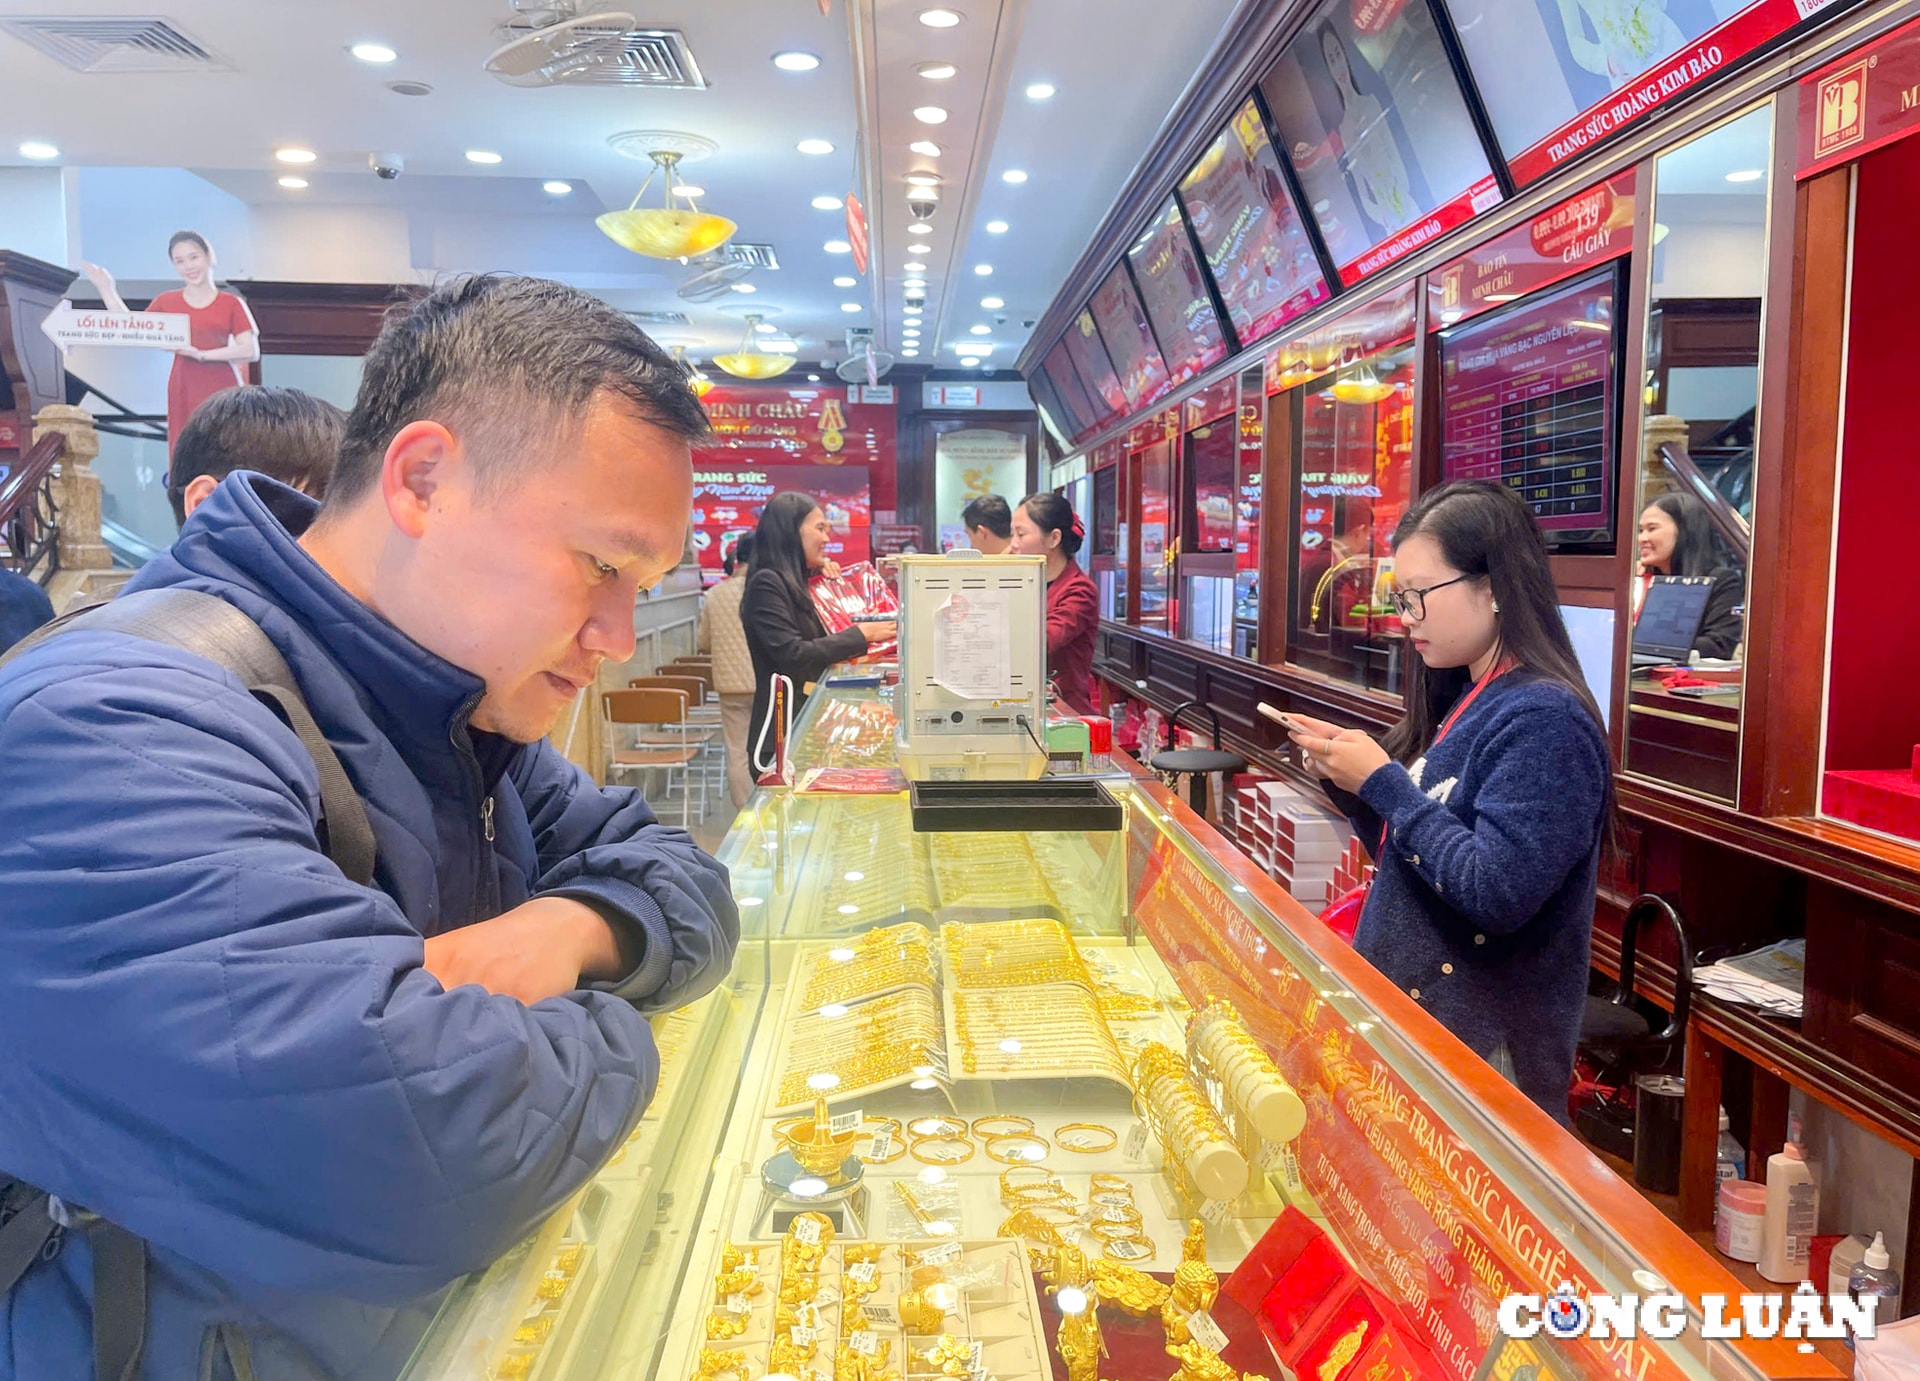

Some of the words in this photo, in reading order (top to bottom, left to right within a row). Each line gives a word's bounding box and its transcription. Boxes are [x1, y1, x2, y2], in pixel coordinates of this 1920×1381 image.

[1547, 131, 1588, 163] TRANG
[1587, 113, 1613, 141] SỨC
[1610, 91, 1660, 126] HOÀNG
[1656, 62, 1692, 98] KIM
[1689, 45, 1723, 75] BẢO
[1576, 203, 1600, 233] 139
[1358, 256, 1380, 276] TRANG
[1389, 236, 1414, 260] HOÀNG
[1411, 229, 1428, 249] KIM
[1424, 218, 1442, 242] BẢO
[1562, 235, 1586, 264] CẦU
[1585, 221, 1612, 254] GIẤY
[1471, 280, 1492, 302] MINH
[1491, 270, 1515, 293] CHÂU
[77, 315, 96, 328] LỐI
[99, 316, 120, 329] LÊN
[122, 316, 155, 331] TẦNG
[157, 321, 165, 331] 2
[756, 400, 809, 418] CHÂU
[692, 472, 735, 483] RANG
[735, 471, 768, 483] SỨC
[1195, 871, 1214, 906] TRANG
[1369, 1063, 1409, 1122] VÀNG
[1408, 1107, 1463, 1183] TRANG
[1460, 1165, 1500, 1223] SỨC
[1326, 1165, 1340, 1192] TIN
[1337, 1182, 1359, 1217] SANG
[1355, 1204, 1383, 1252] TRỌNG
[1384, 1249, 1411, 1290] KHẮC
[1426, 1306, 1454, 1353] TÍNH
[1463, 1233, 1504, 1297] THĂNG
